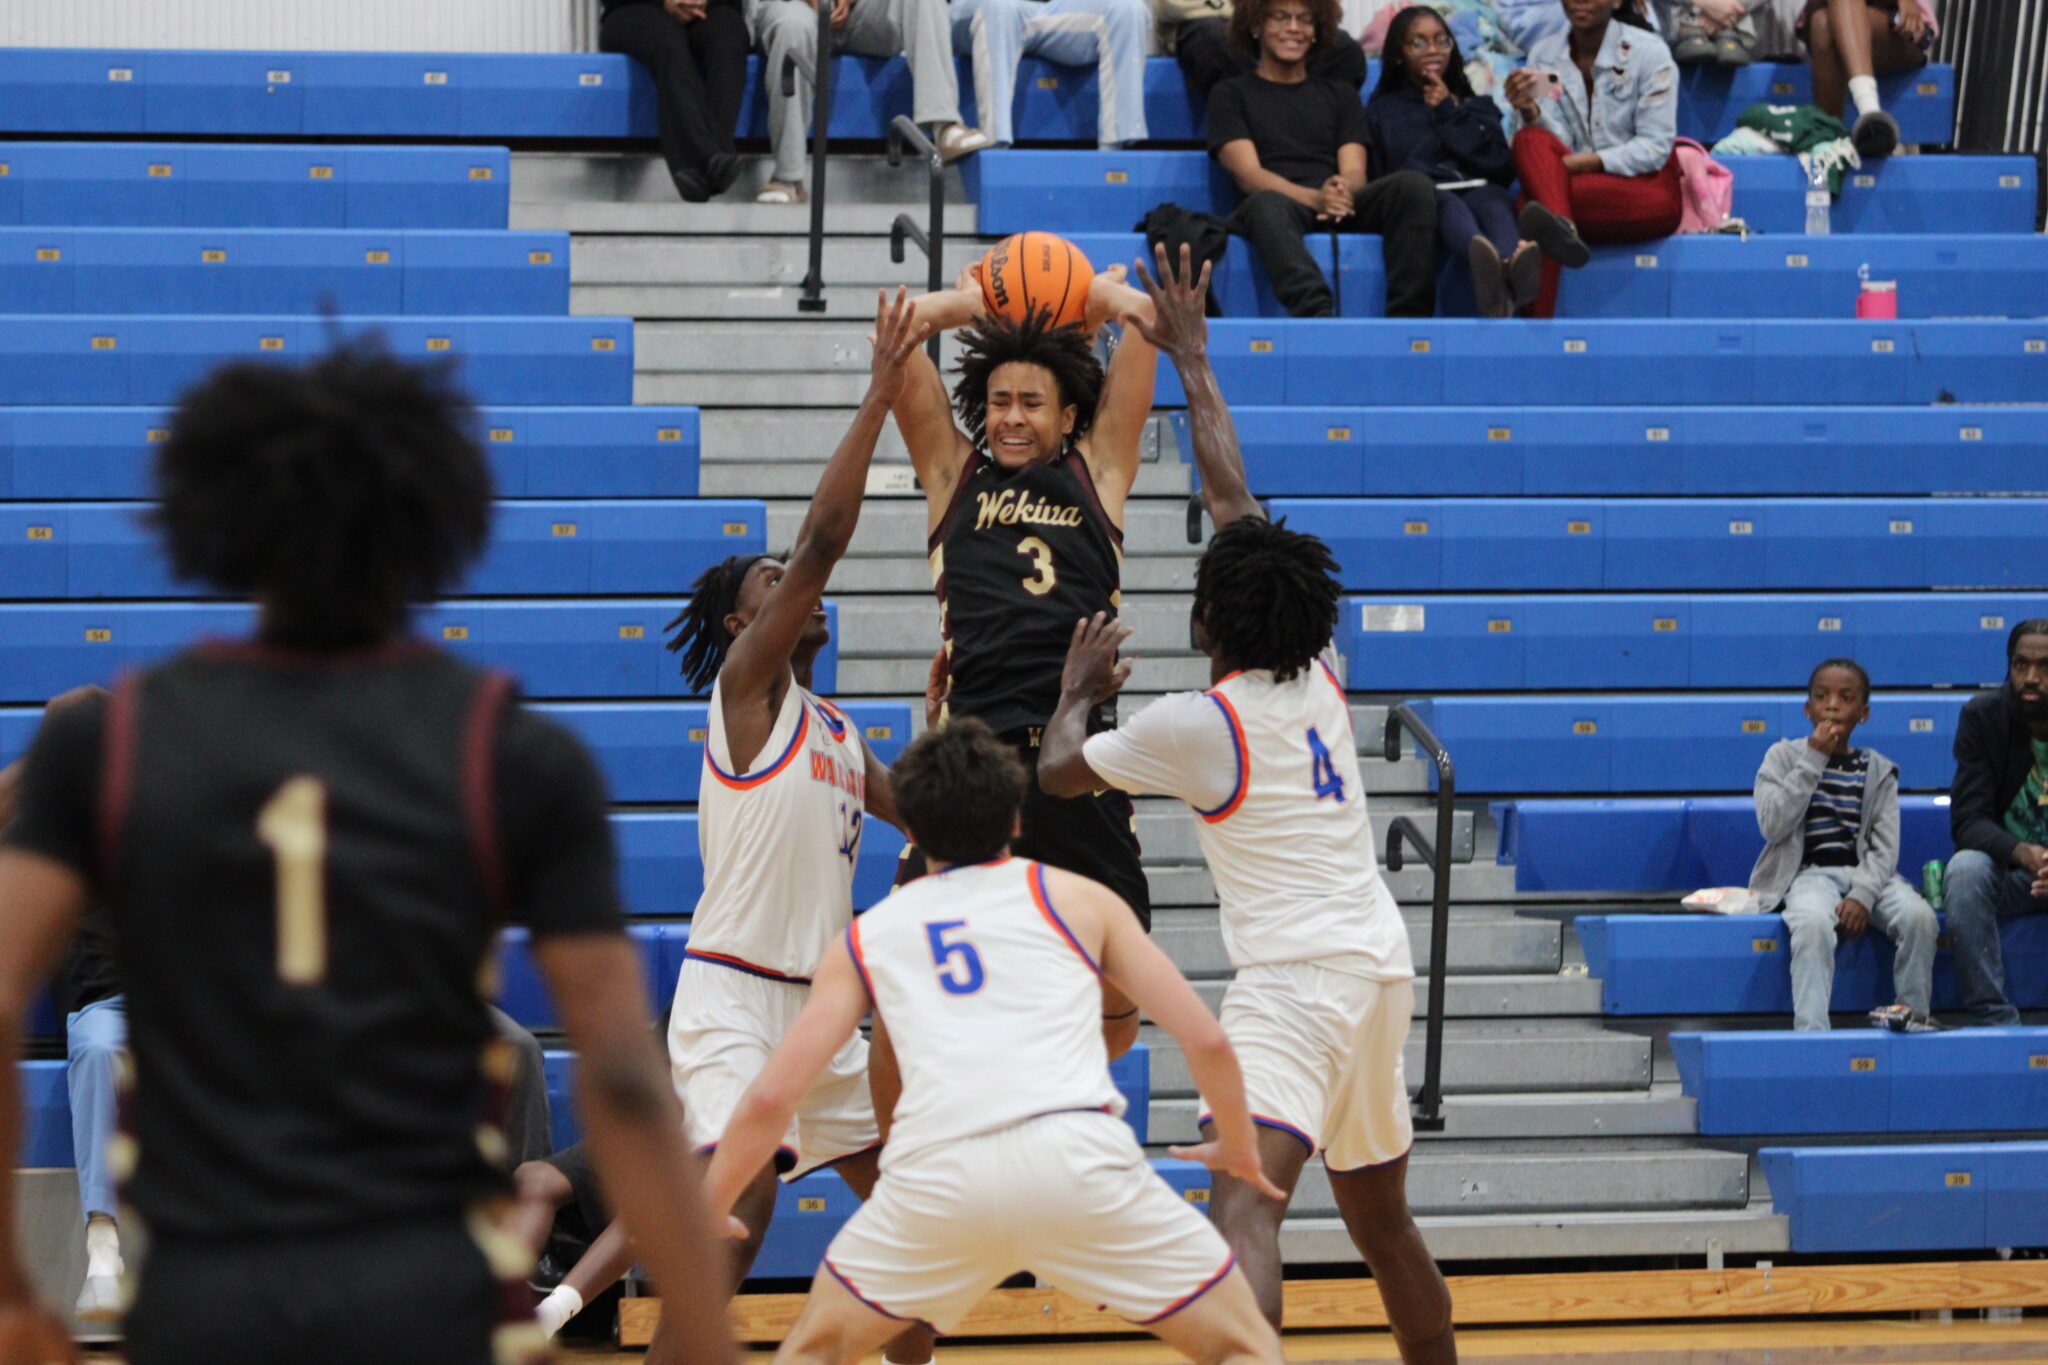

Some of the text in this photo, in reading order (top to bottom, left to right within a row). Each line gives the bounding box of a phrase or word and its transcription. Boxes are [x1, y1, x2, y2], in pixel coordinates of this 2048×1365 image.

[974, 488, 1083, 531] Wekiva
[1017, 536, 1056, 595] 3
[1306, 725, 1347, 804] 4
[838, 801, 863, 866] 12
[257, 775, 328, 985] 1
[922, 918, 986, 997] 5
[1471, 1182, 1480, 1192] A
